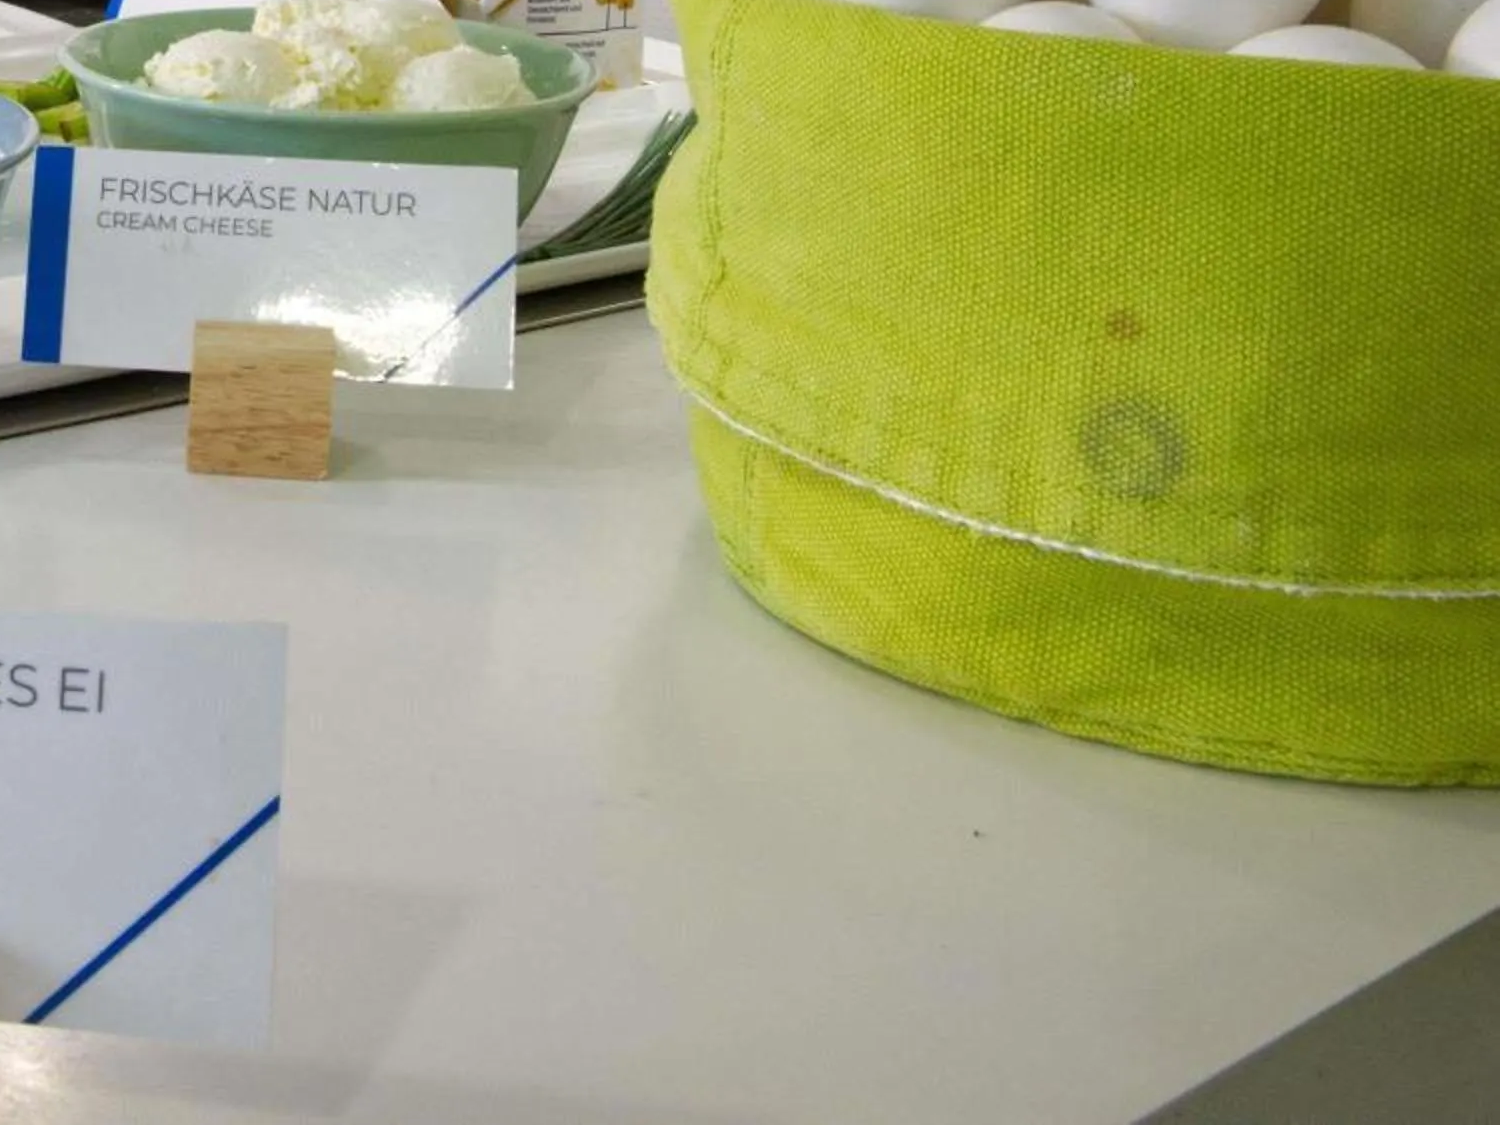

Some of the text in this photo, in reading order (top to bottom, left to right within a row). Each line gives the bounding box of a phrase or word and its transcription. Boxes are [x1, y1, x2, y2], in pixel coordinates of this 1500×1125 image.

[100, 177, 417, 218] FRISCHKÄSE NATUR
[96, 211, 274, 238] CREAM CHEESE
[58, 668, 106, 714] EI
